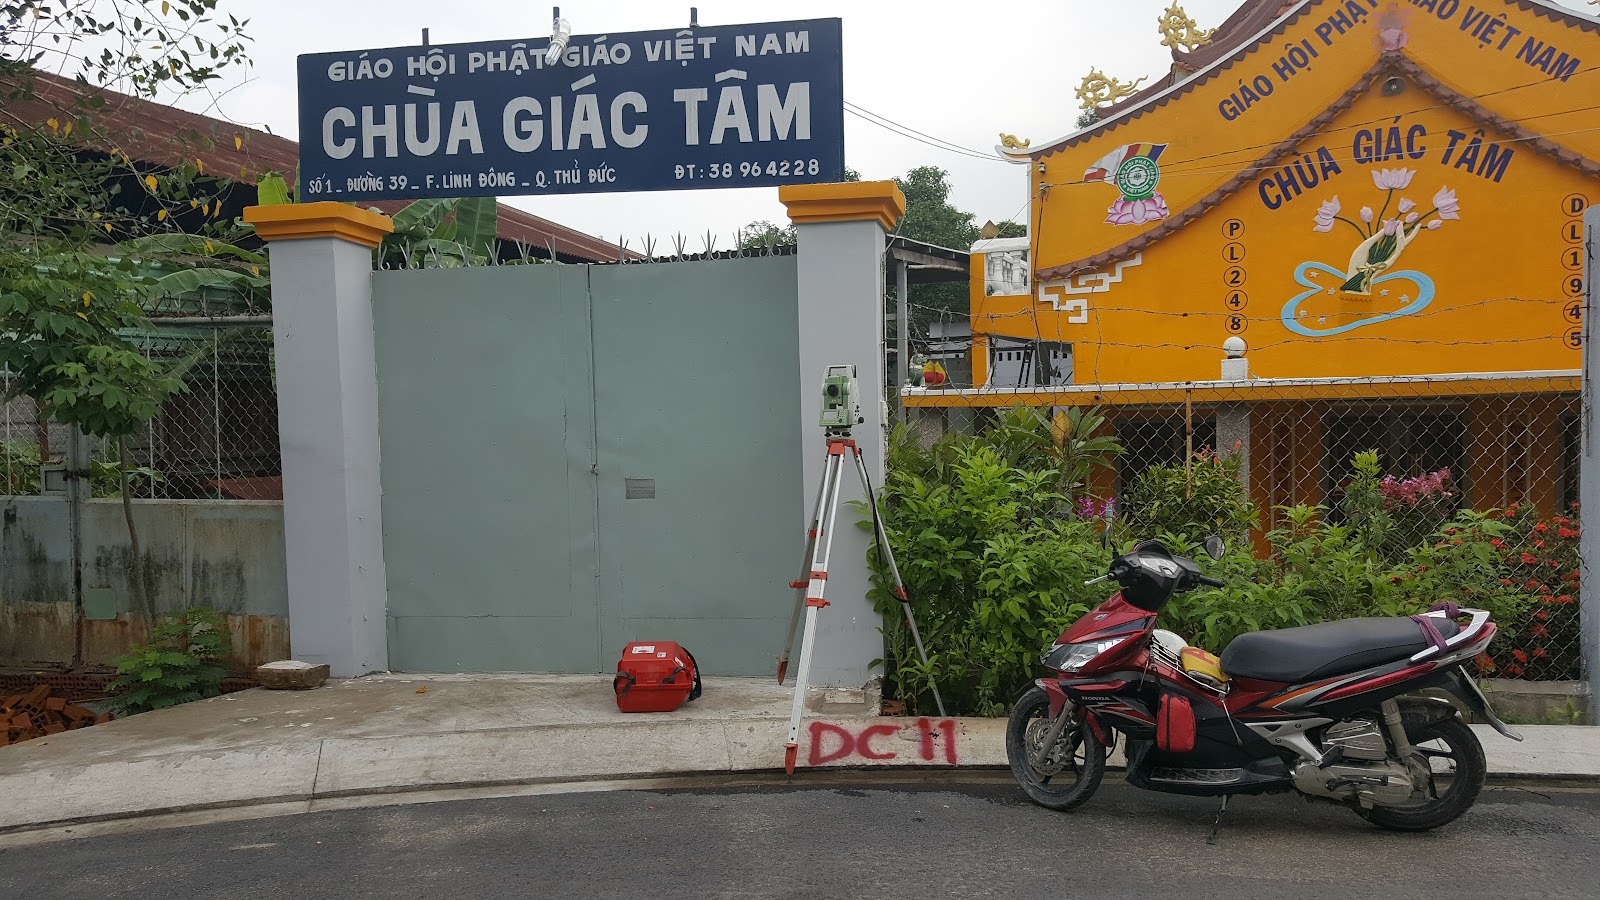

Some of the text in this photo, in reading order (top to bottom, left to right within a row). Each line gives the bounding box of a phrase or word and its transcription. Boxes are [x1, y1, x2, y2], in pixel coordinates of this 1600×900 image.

[327, 30, 810, 82] GIÁO HỘI PHẬT GIÁO VIỆT NAM
[1218, 78, 1275, 122] GIÁO
[1271, 42, 1319, 82] HỘI
[1458, 5, 1522, 50] VIỆT
[1515, 36, 1581, 83] NAM
[322, 69, 811, 160] CHÙA GIÁC TÂM
[308, 172, 325, 194] SỐ
[347, 170, 384, 192] ĐƯỜNG
[388, 175, 408, 191] 39
[478, 166, 516, 188] ĐÔNG
[553, 159, 581, 185] THỦ
[587, 161, 617, 184] ĐỨC
[1258, 116, 1515, 210] CHÙA GIÁC TÂM
[808, 721, 902, 766] DC
